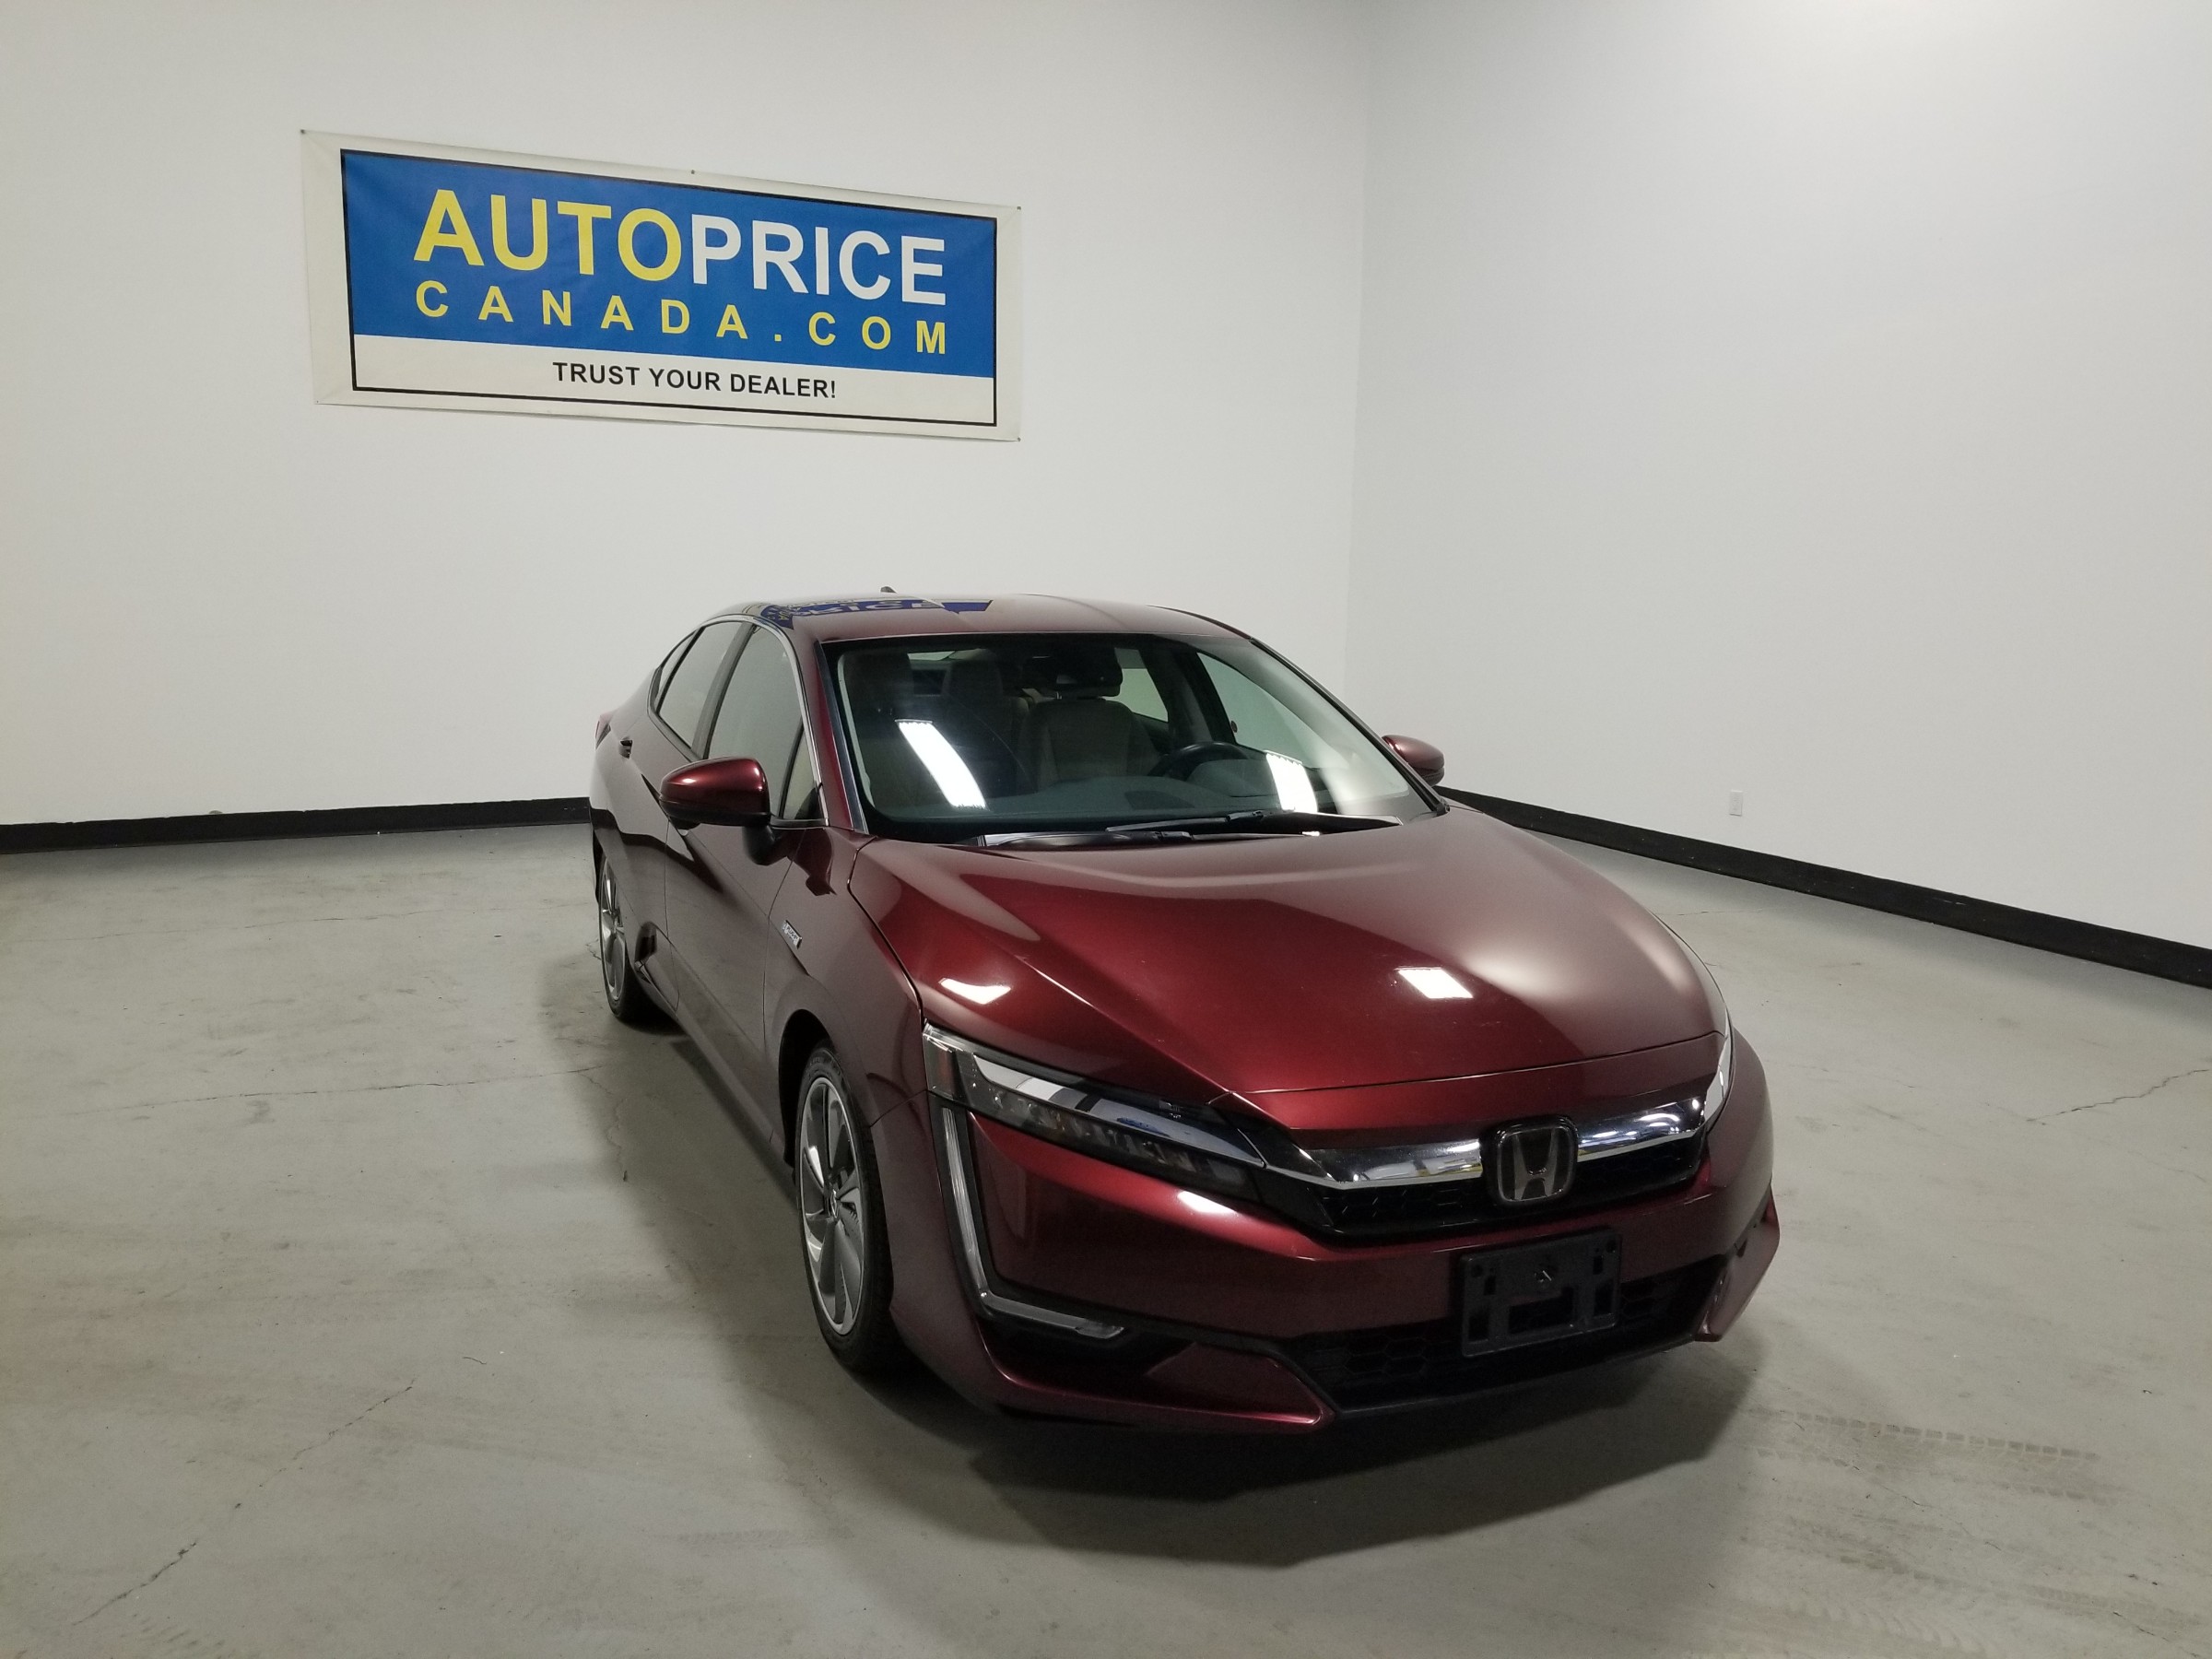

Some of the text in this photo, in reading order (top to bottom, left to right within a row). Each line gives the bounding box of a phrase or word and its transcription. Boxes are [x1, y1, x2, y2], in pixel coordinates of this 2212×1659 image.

[414, 189, 946, 306] AUTOPRICE
[416, 279, 946, 355] CANADA.COM
[553, 362, 836, 398] TRUST YOUR DEALER!
